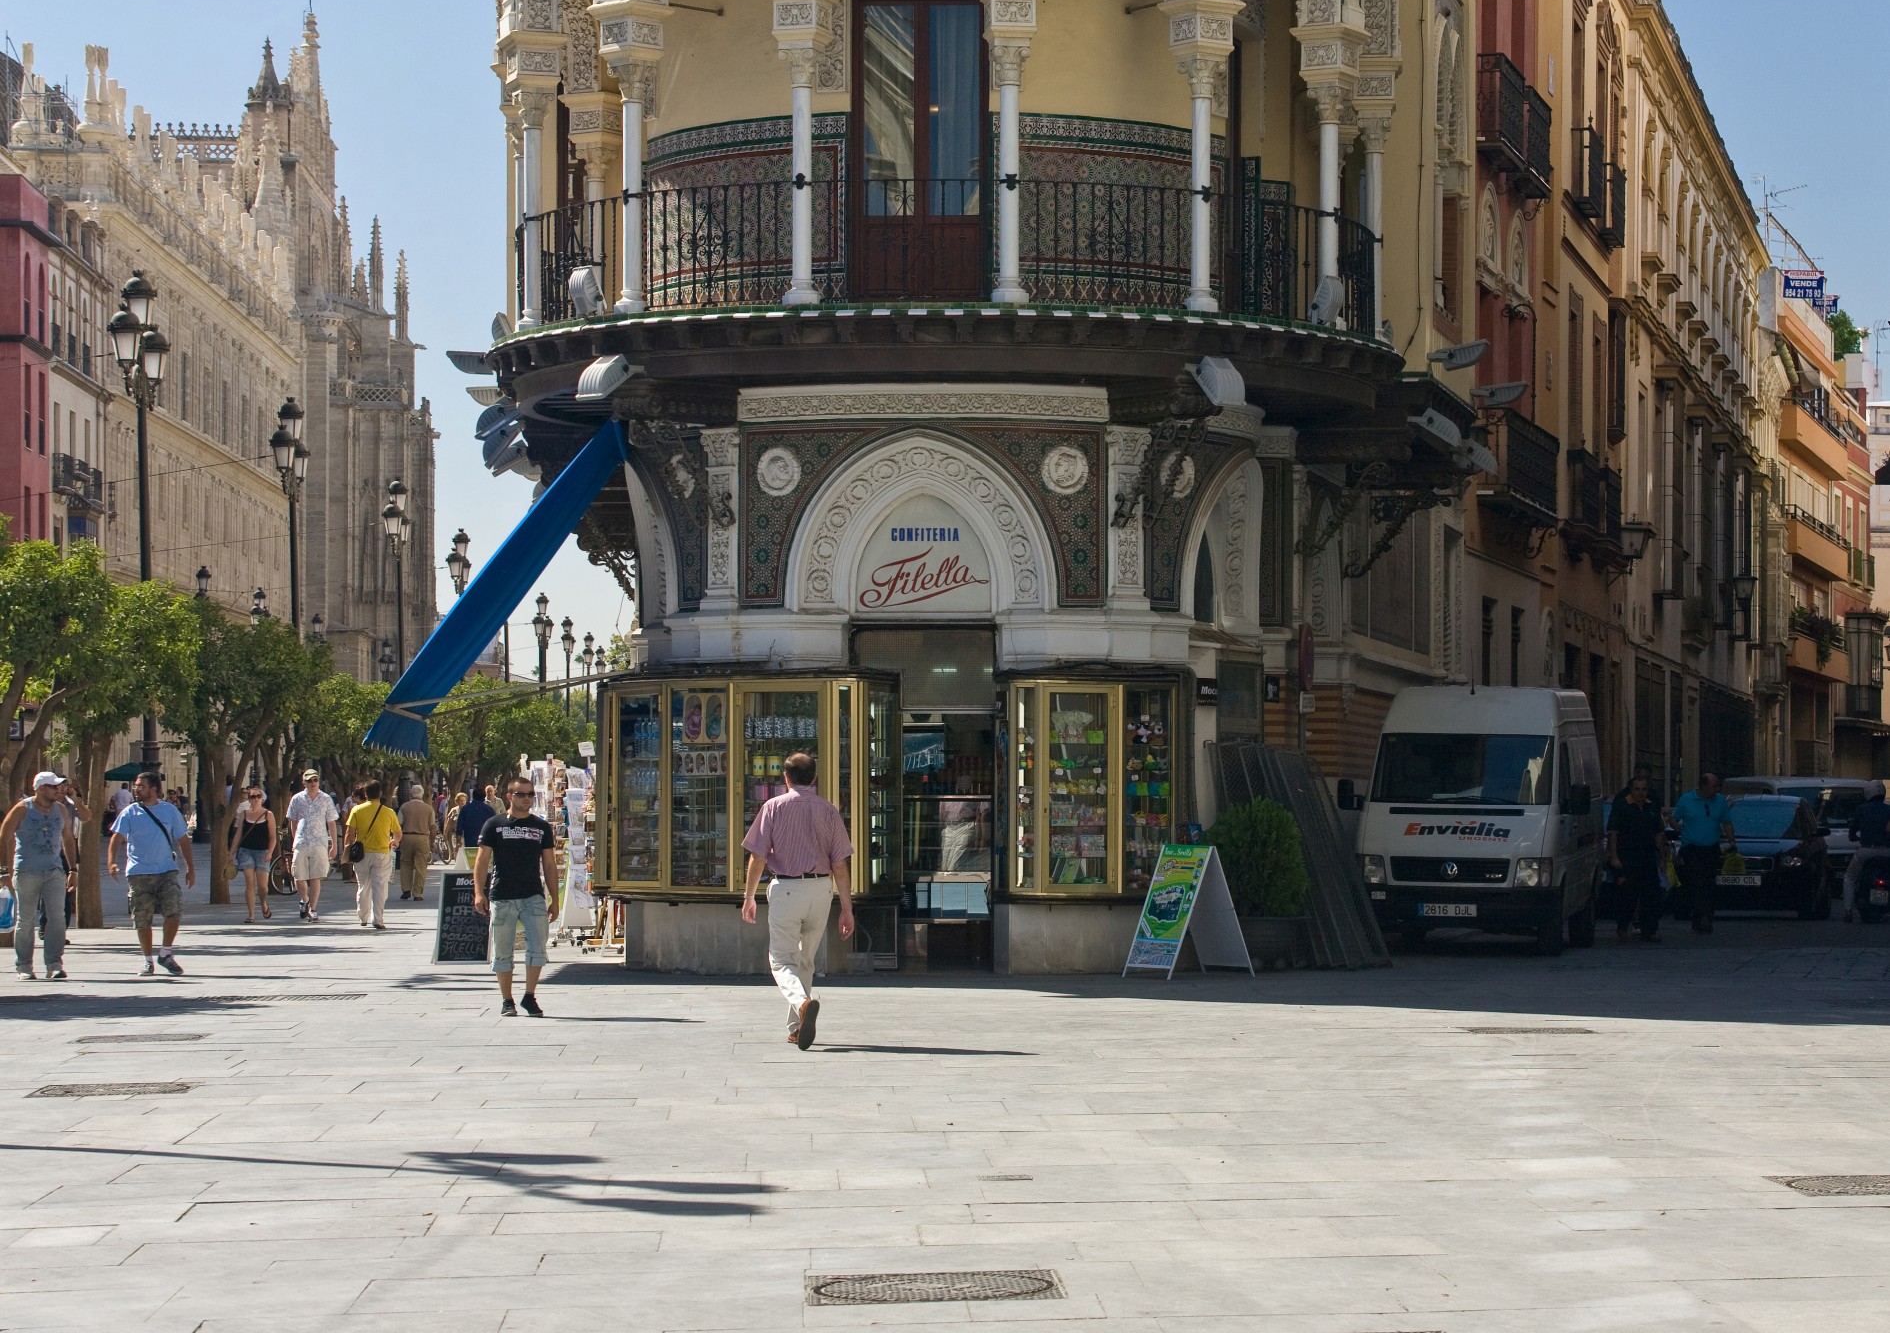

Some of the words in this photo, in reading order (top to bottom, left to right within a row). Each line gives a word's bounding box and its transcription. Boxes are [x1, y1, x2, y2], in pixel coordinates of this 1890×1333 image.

[891, 527, 960, 542] CONFITERIA
[860, 545, 989, 608] Filella
[1424, 905, 1448, 915] 2816
[1454, 905, 1472, 915] DJL
